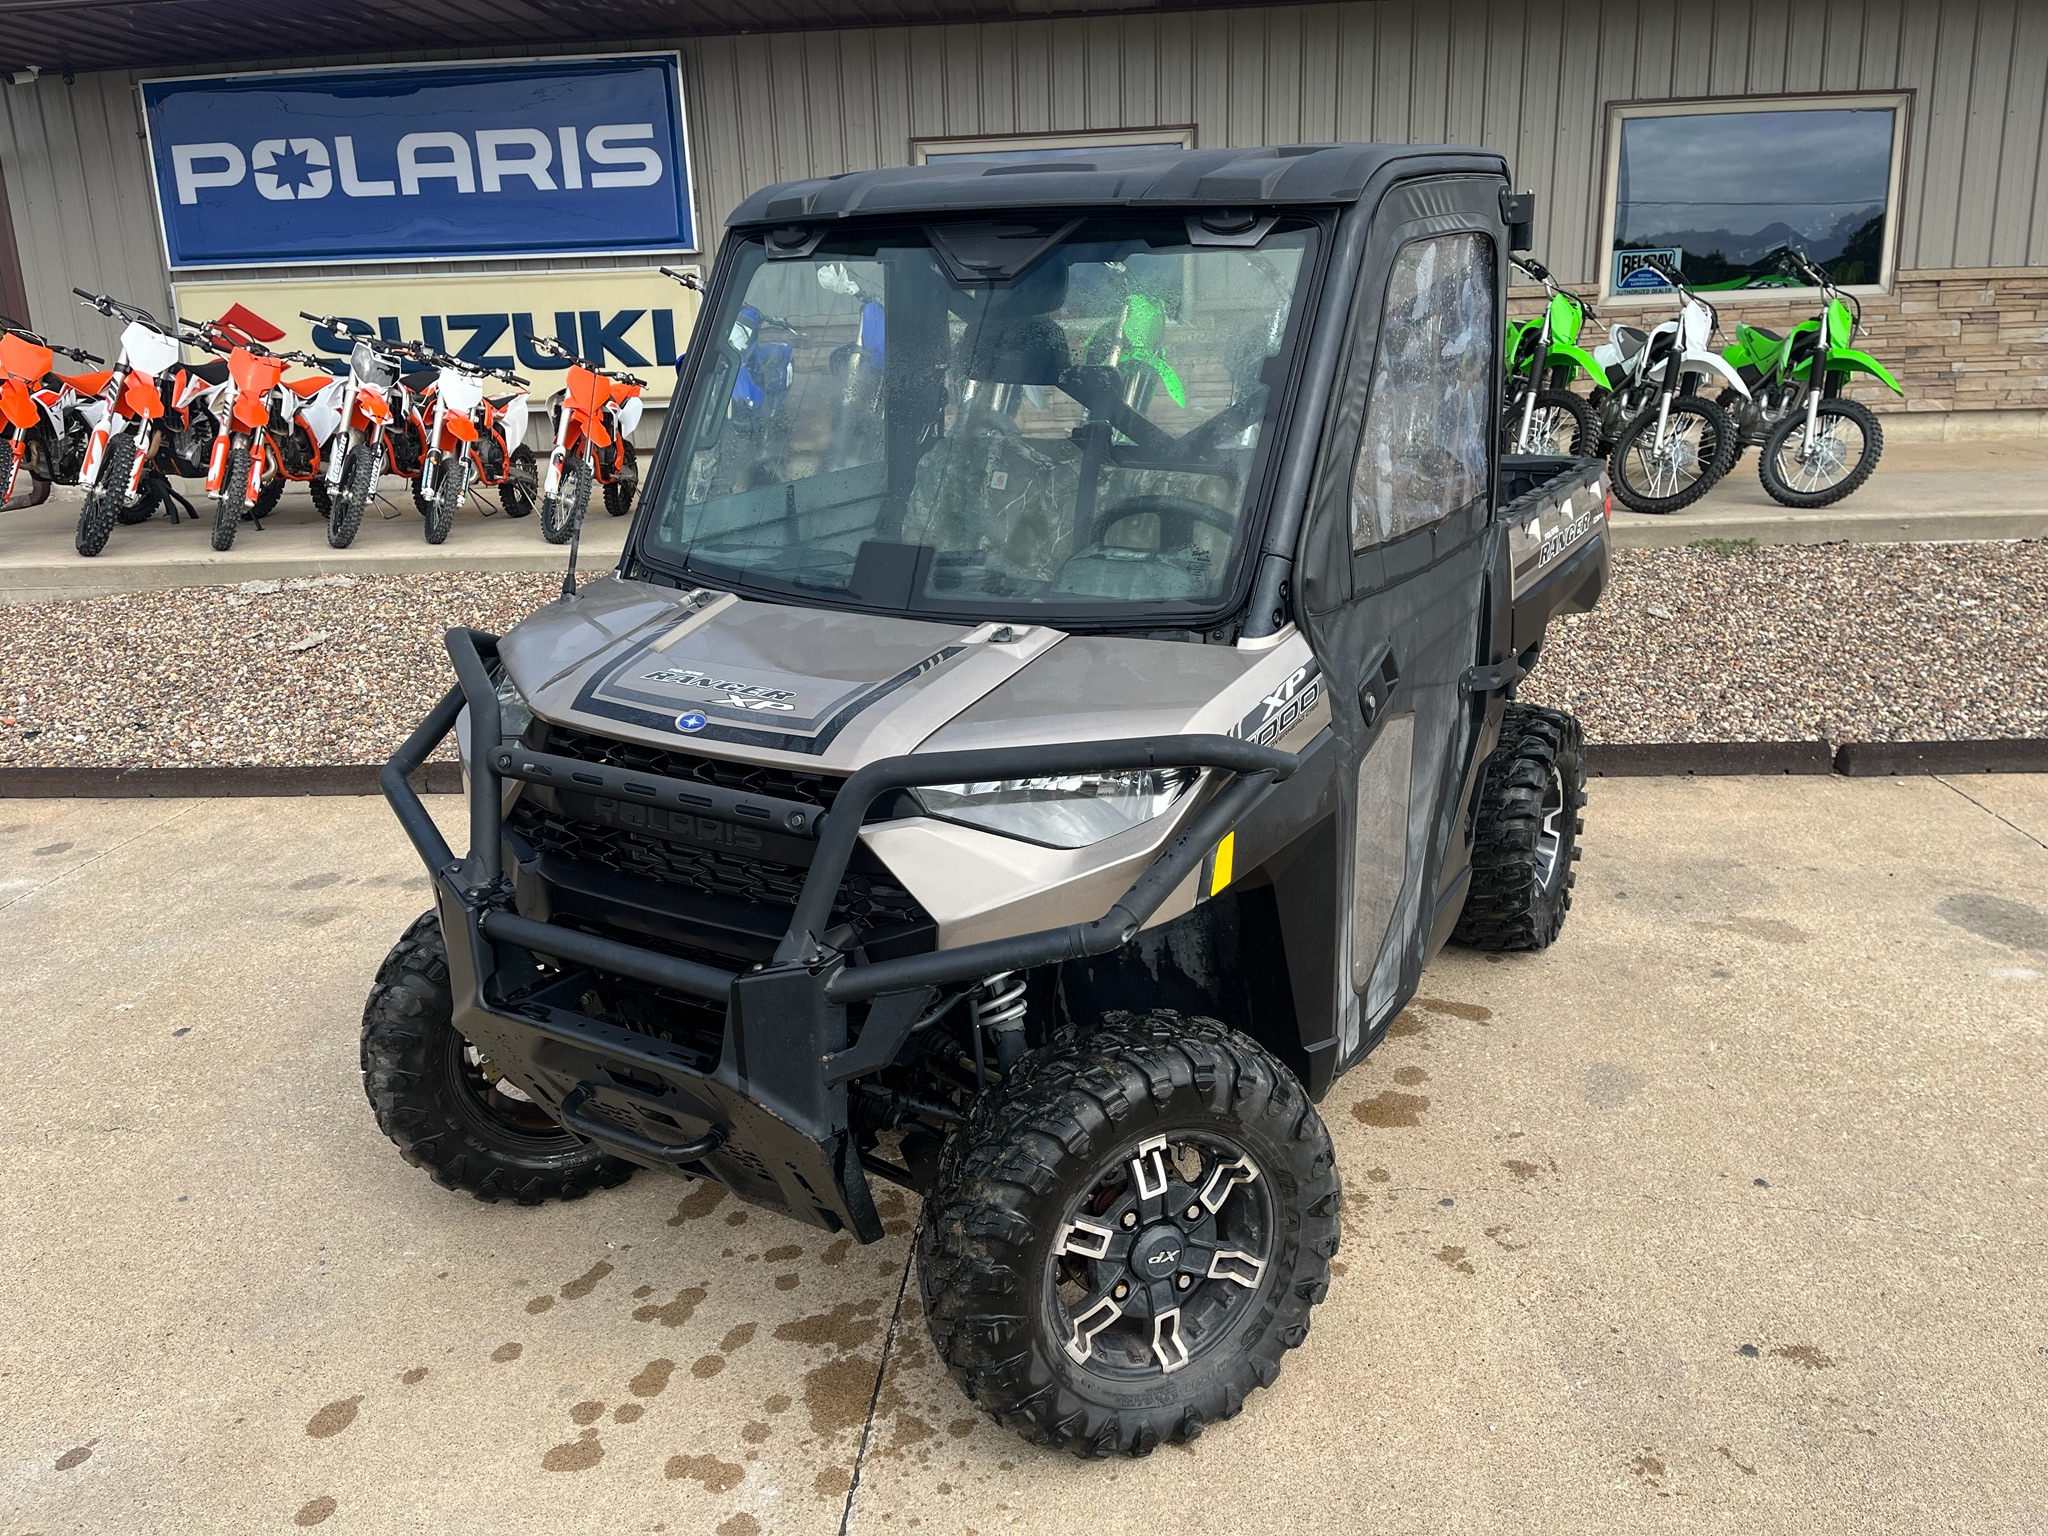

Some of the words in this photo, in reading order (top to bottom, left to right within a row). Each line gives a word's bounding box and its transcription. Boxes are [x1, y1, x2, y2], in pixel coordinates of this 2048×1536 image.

[171, 123, 663, 204] POLARIS
[1621, 253, 1673, 283] BELAY
[1616, 288, 1650, 296] AUTHORIZED
[312, 308, 676, 377] SUZUKI
[1538, 511, 1591, 569] RANGER
[640, 671, 797, 701] RANGER
[711, 693, 796, 711] XP
[1261, 667, 1307, 722] XP
[1246, 680, 1320, 747] 000
[1148, 1248, 1181, 1264] XP
